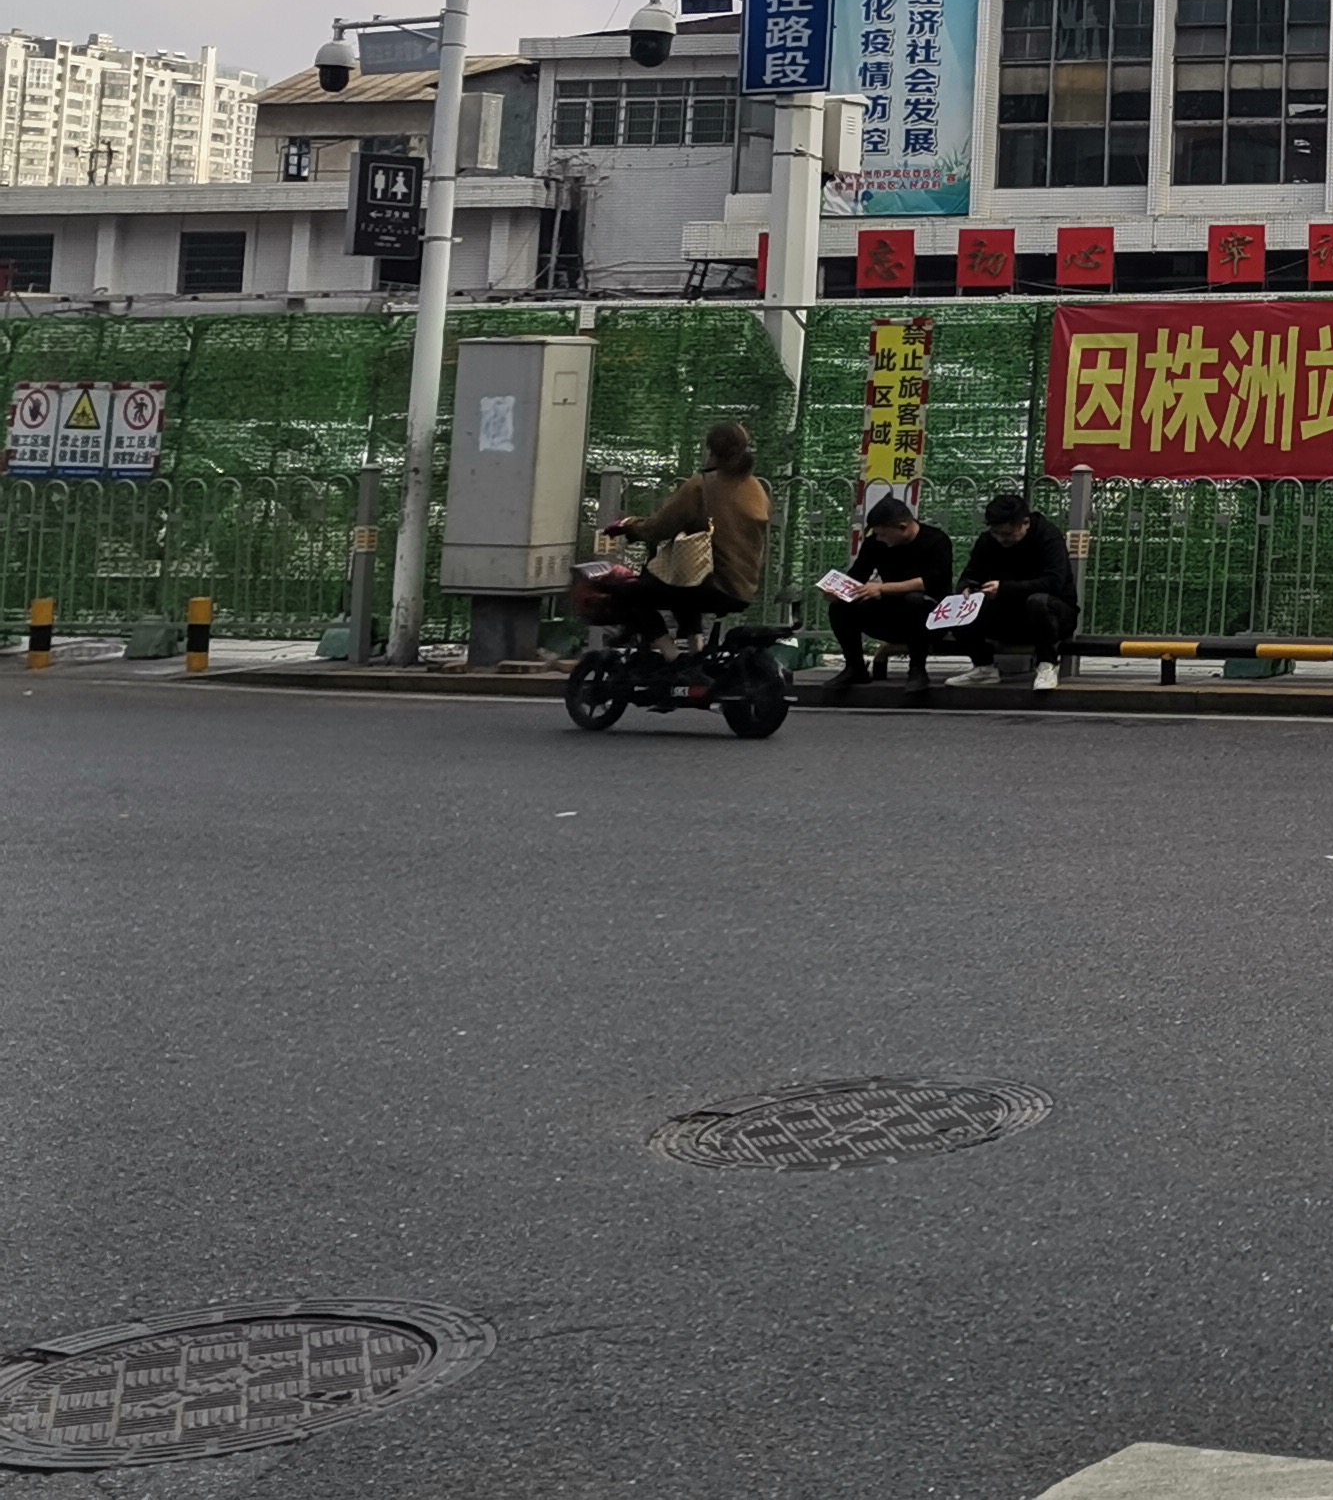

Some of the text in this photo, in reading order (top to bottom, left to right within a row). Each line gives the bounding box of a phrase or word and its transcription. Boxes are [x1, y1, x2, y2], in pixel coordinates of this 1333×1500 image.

[869, 347, 898, 447] 此区域
[892, 325, 926, 481] 禁止旅客乘降
[932, 600, 978, 624] 长沙
